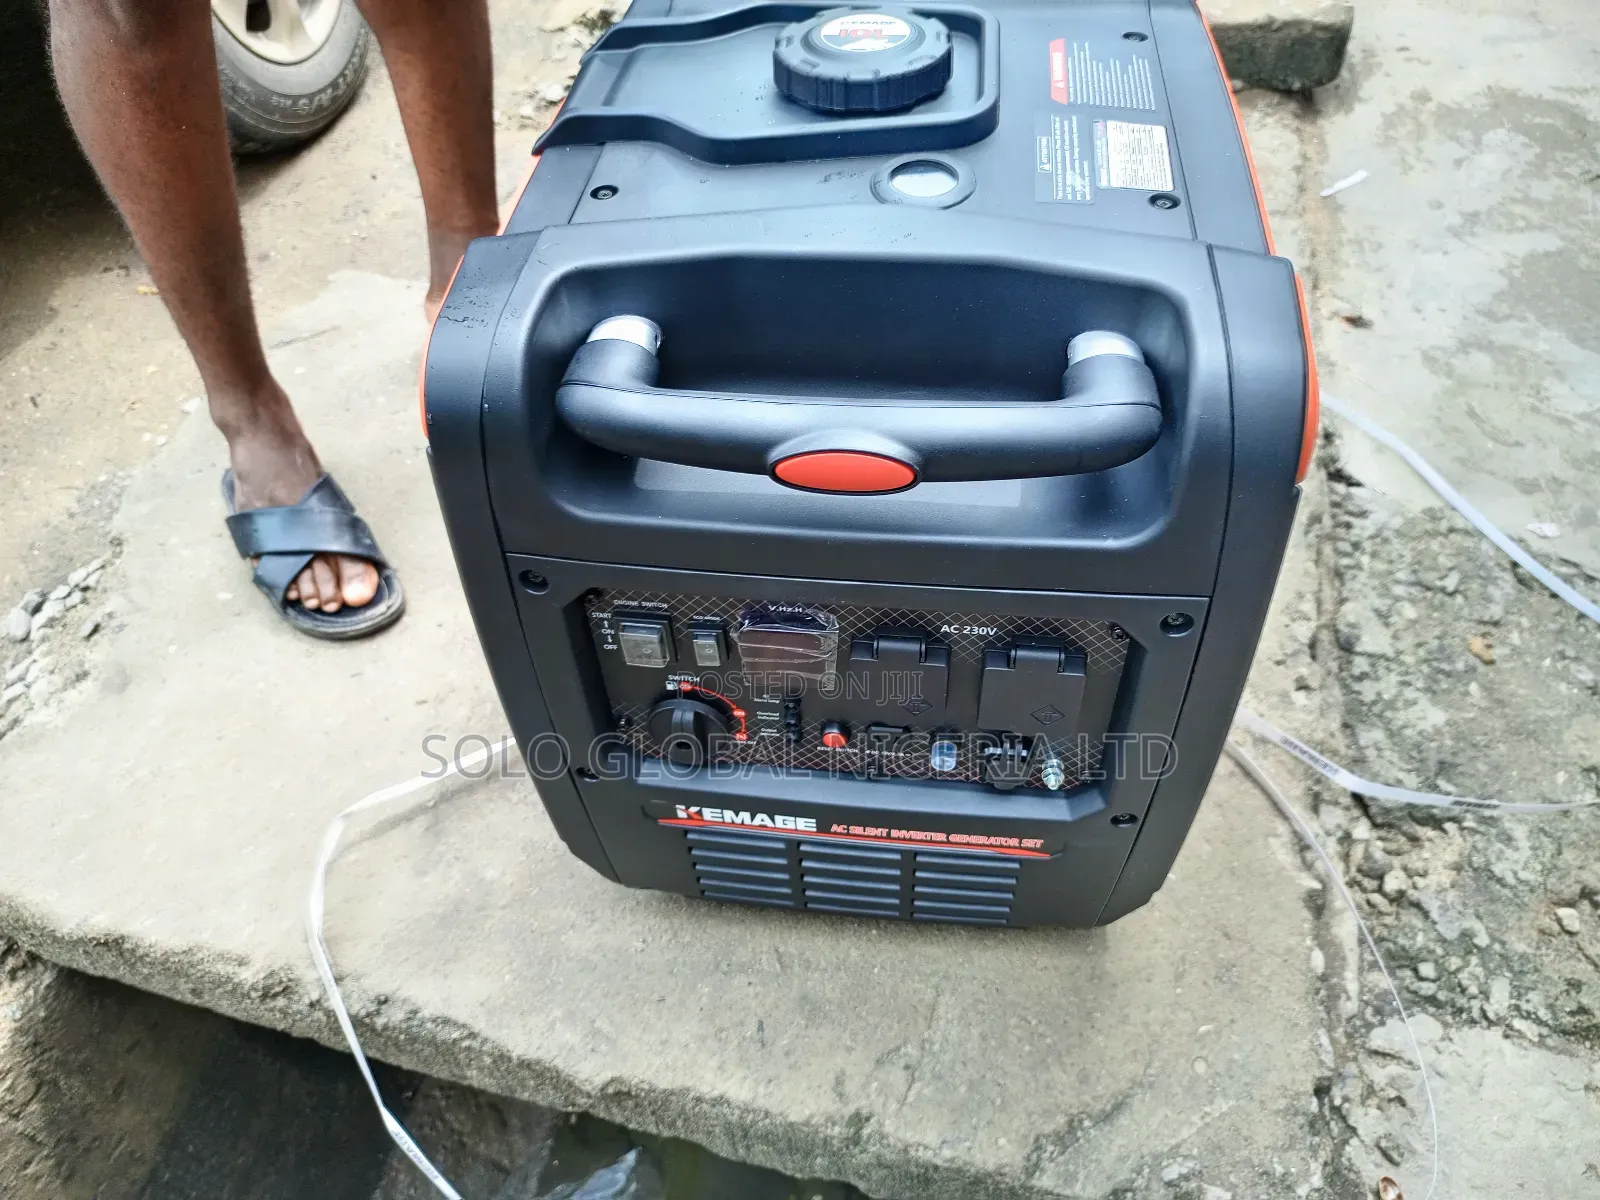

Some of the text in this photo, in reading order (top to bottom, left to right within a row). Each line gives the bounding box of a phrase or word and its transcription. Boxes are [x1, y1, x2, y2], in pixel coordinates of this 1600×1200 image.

[613, 599, 639, 607] ENGINE
[940, 624, 998, 636] AC 230V
[667, 674, 700, 682] SWITCH
[675, 804, 817, 832] KEMAGE
[830, 823, 1044, 848] AC SILENT INVERTER GENERATOR SET
